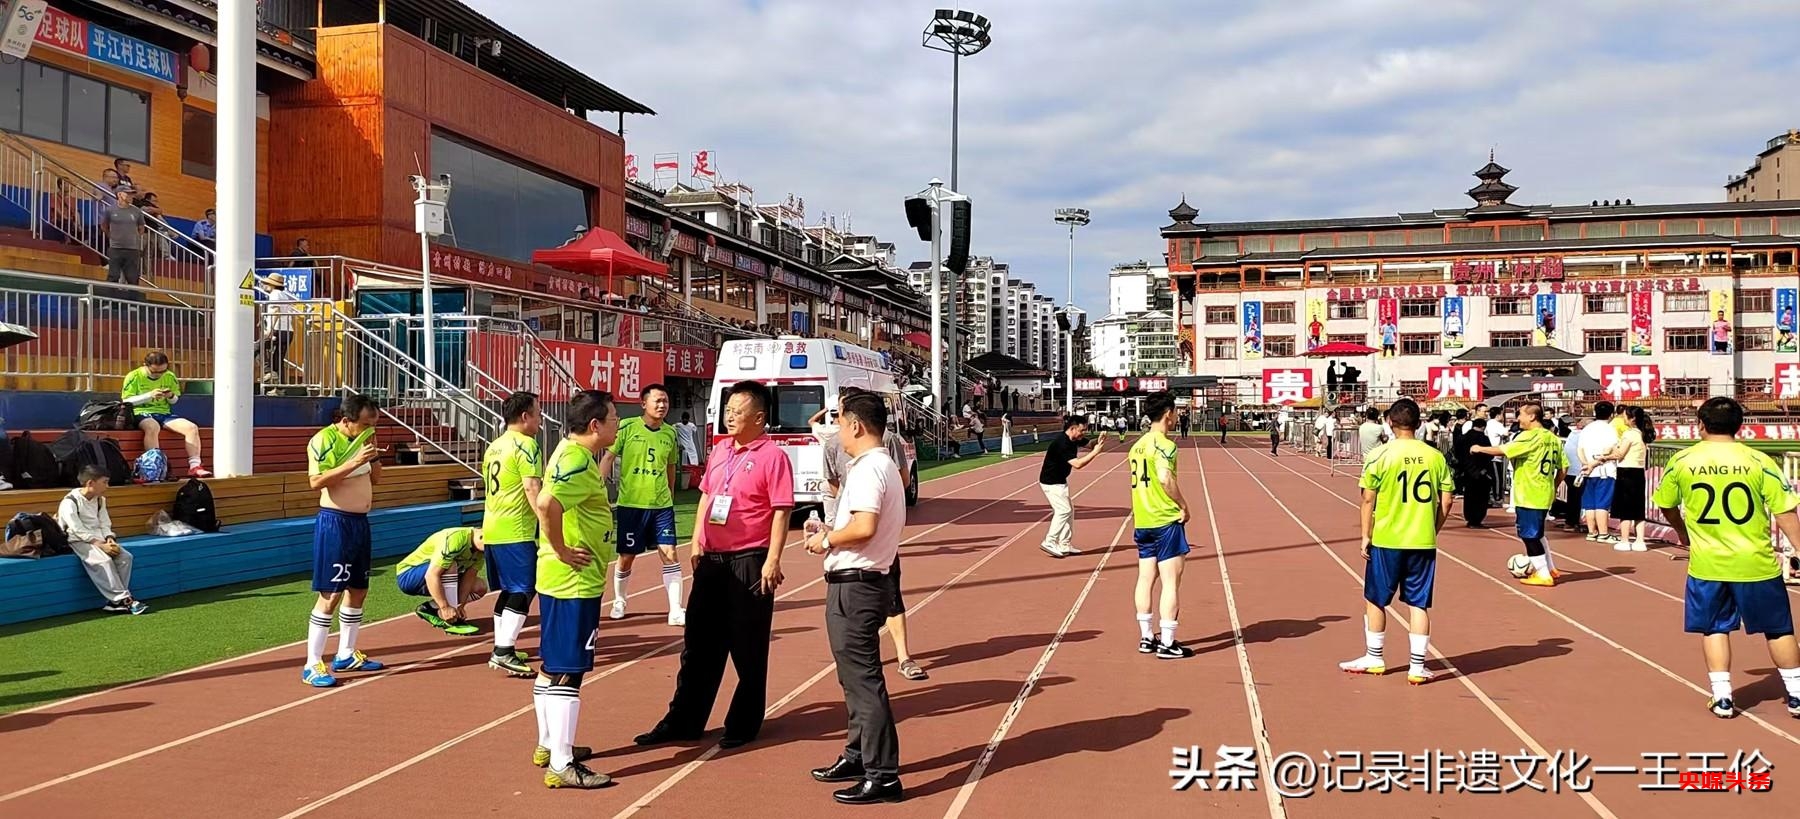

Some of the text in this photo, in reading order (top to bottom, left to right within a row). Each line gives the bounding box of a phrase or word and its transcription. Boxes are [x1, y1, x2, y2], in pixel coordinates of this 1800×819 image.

[18, 5, 34, 21] 5G
[38, 12, 84, 50] 足球队
[93, 28, 173, 79] 平江村足球队
[666, 346, 705, 375] 有追求
[784, 341, 807, 354] 急救
[1266, 366, 1656, 404] 贵 州 村
[647, 447, 656, 463] 5
[1404, 456, 1424, 466] BYE
[486, 460, 501, 496] 18
[1131, 458, 1151, 489] 34
[1689, 465, 1751, 476] YANG HY
[1397, 469, 1433, 504] 16
[1691, 481, 1755, 526] 20
[626, 532, 636, 547] 5
[330, 563, 352, 583] 25
